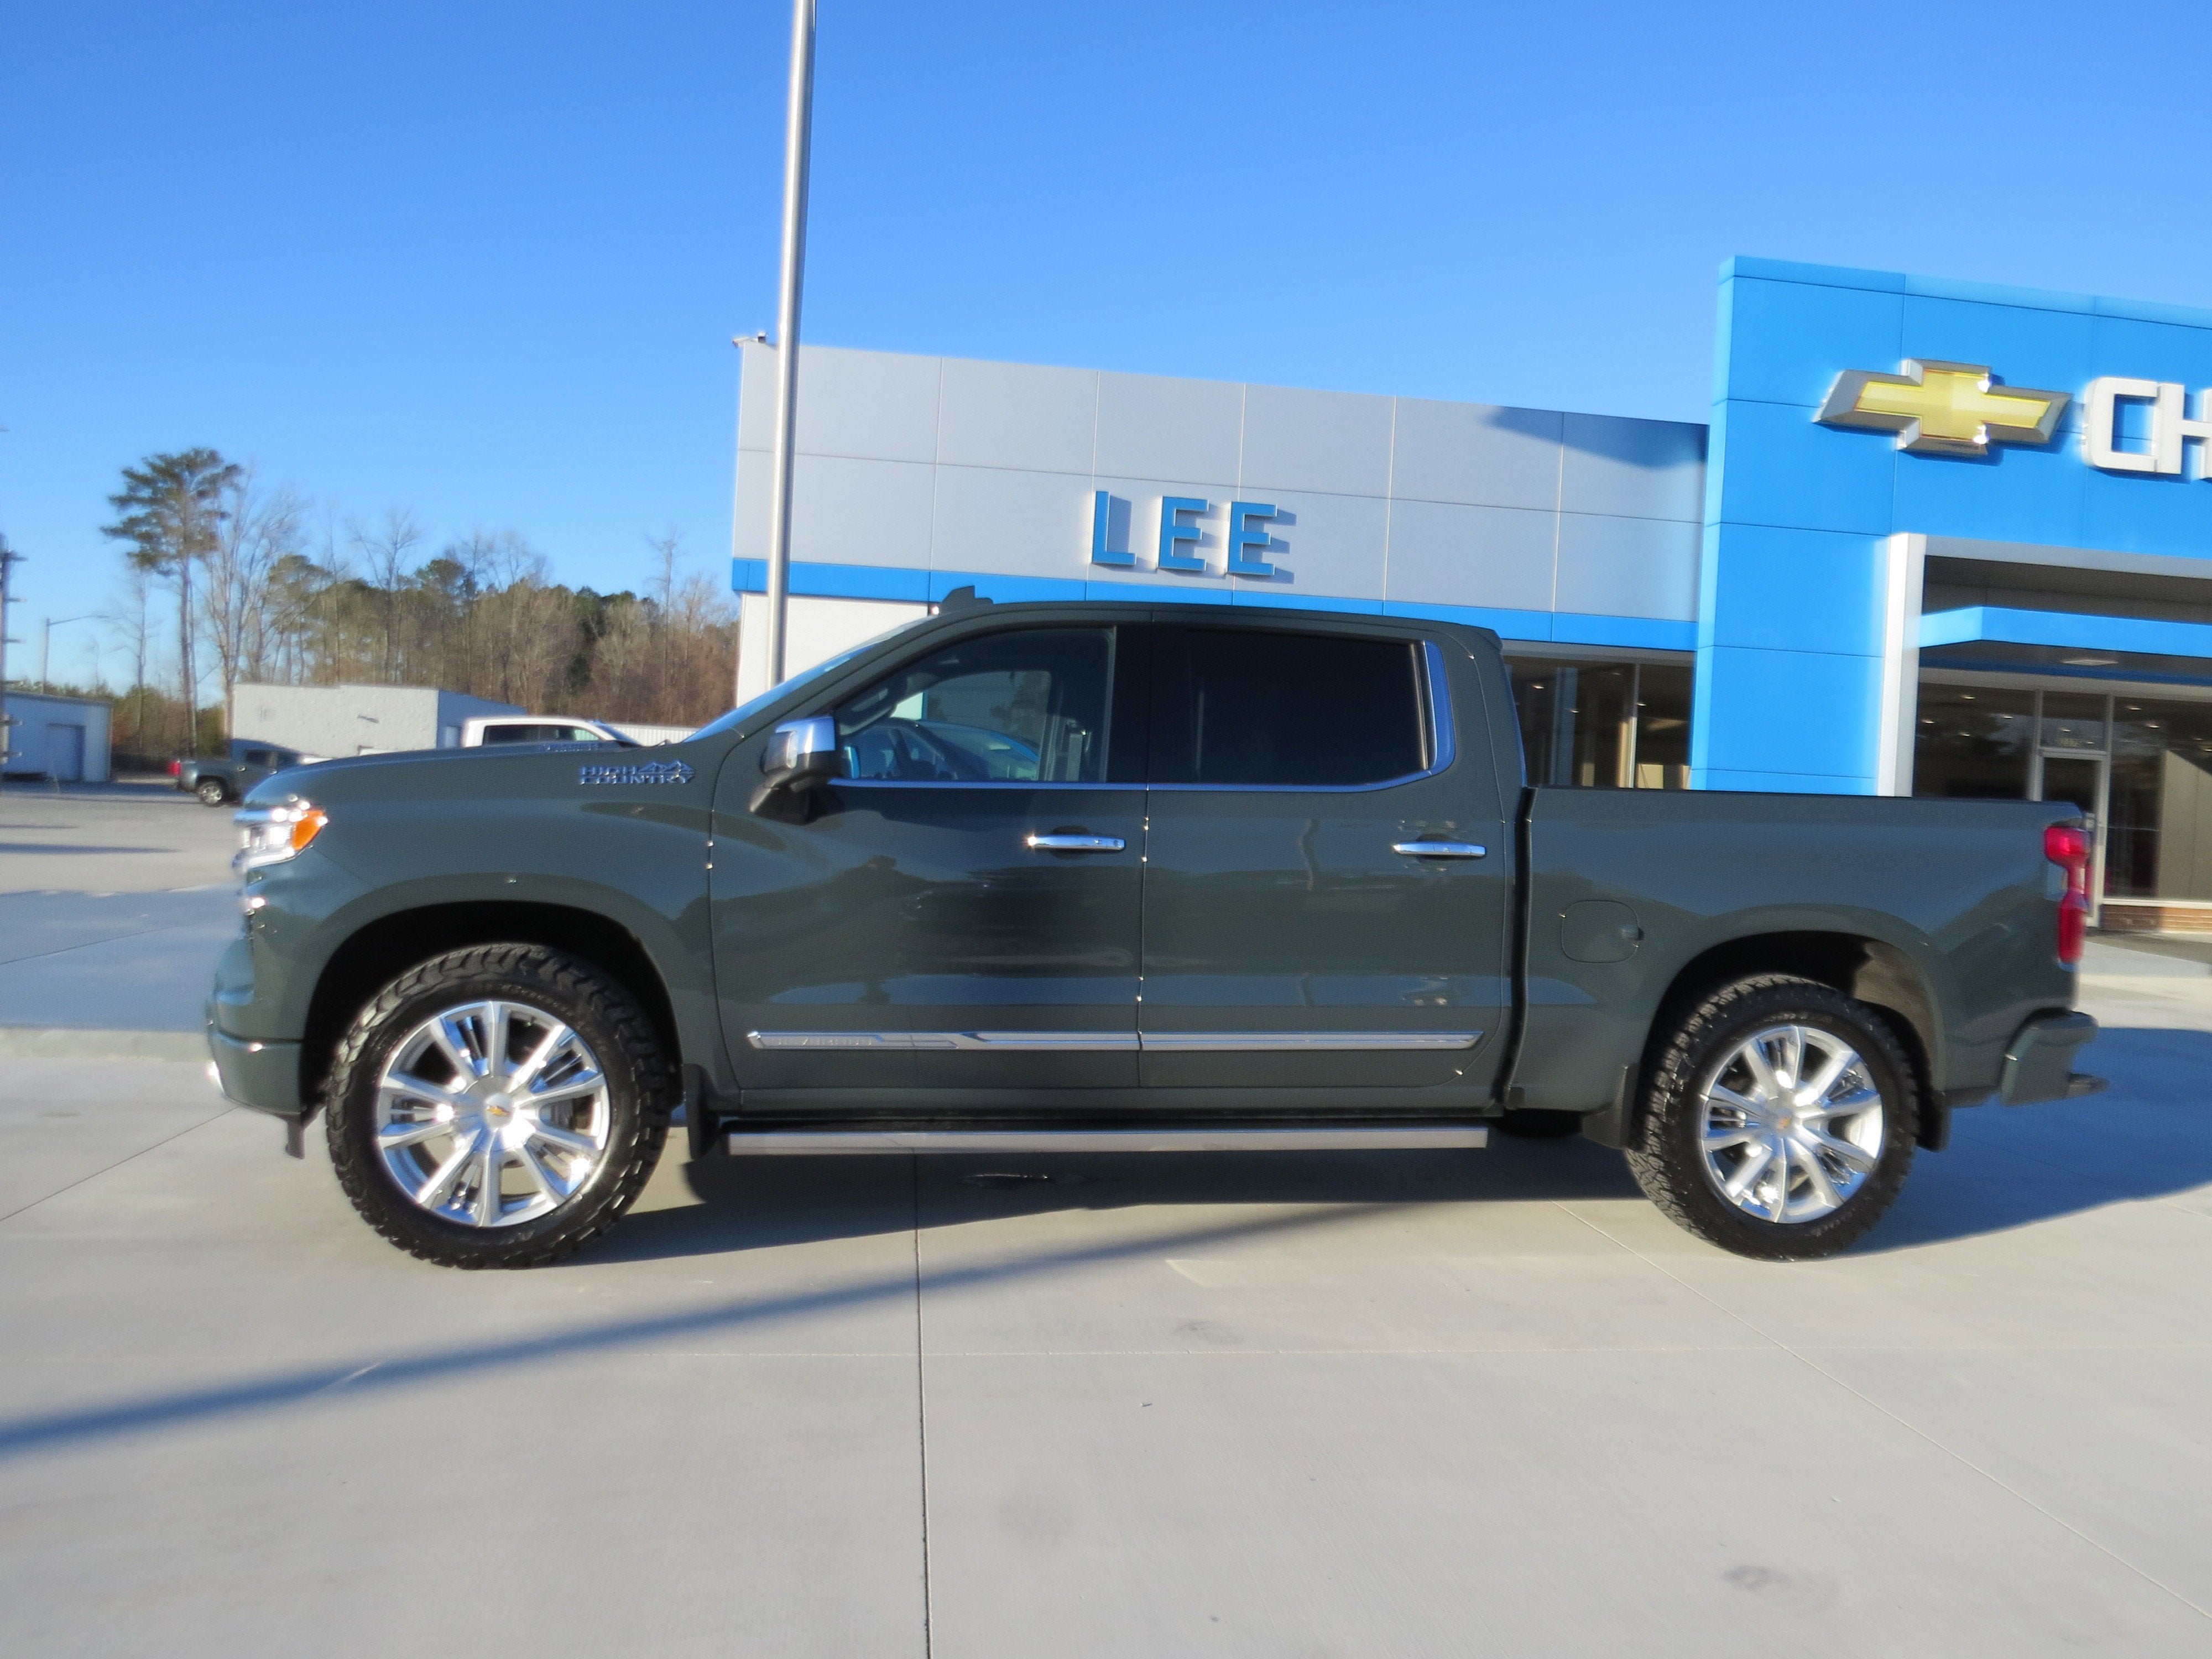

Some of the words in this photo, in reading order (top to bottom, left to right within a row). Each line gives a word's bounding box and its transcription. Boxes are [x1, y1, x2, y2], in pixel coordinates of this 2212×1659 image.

[1092, 490, 1277, 576] LEE
[579, 765, 637, 775] HIGH
[579, 774, 692, 785] COUNTRY
